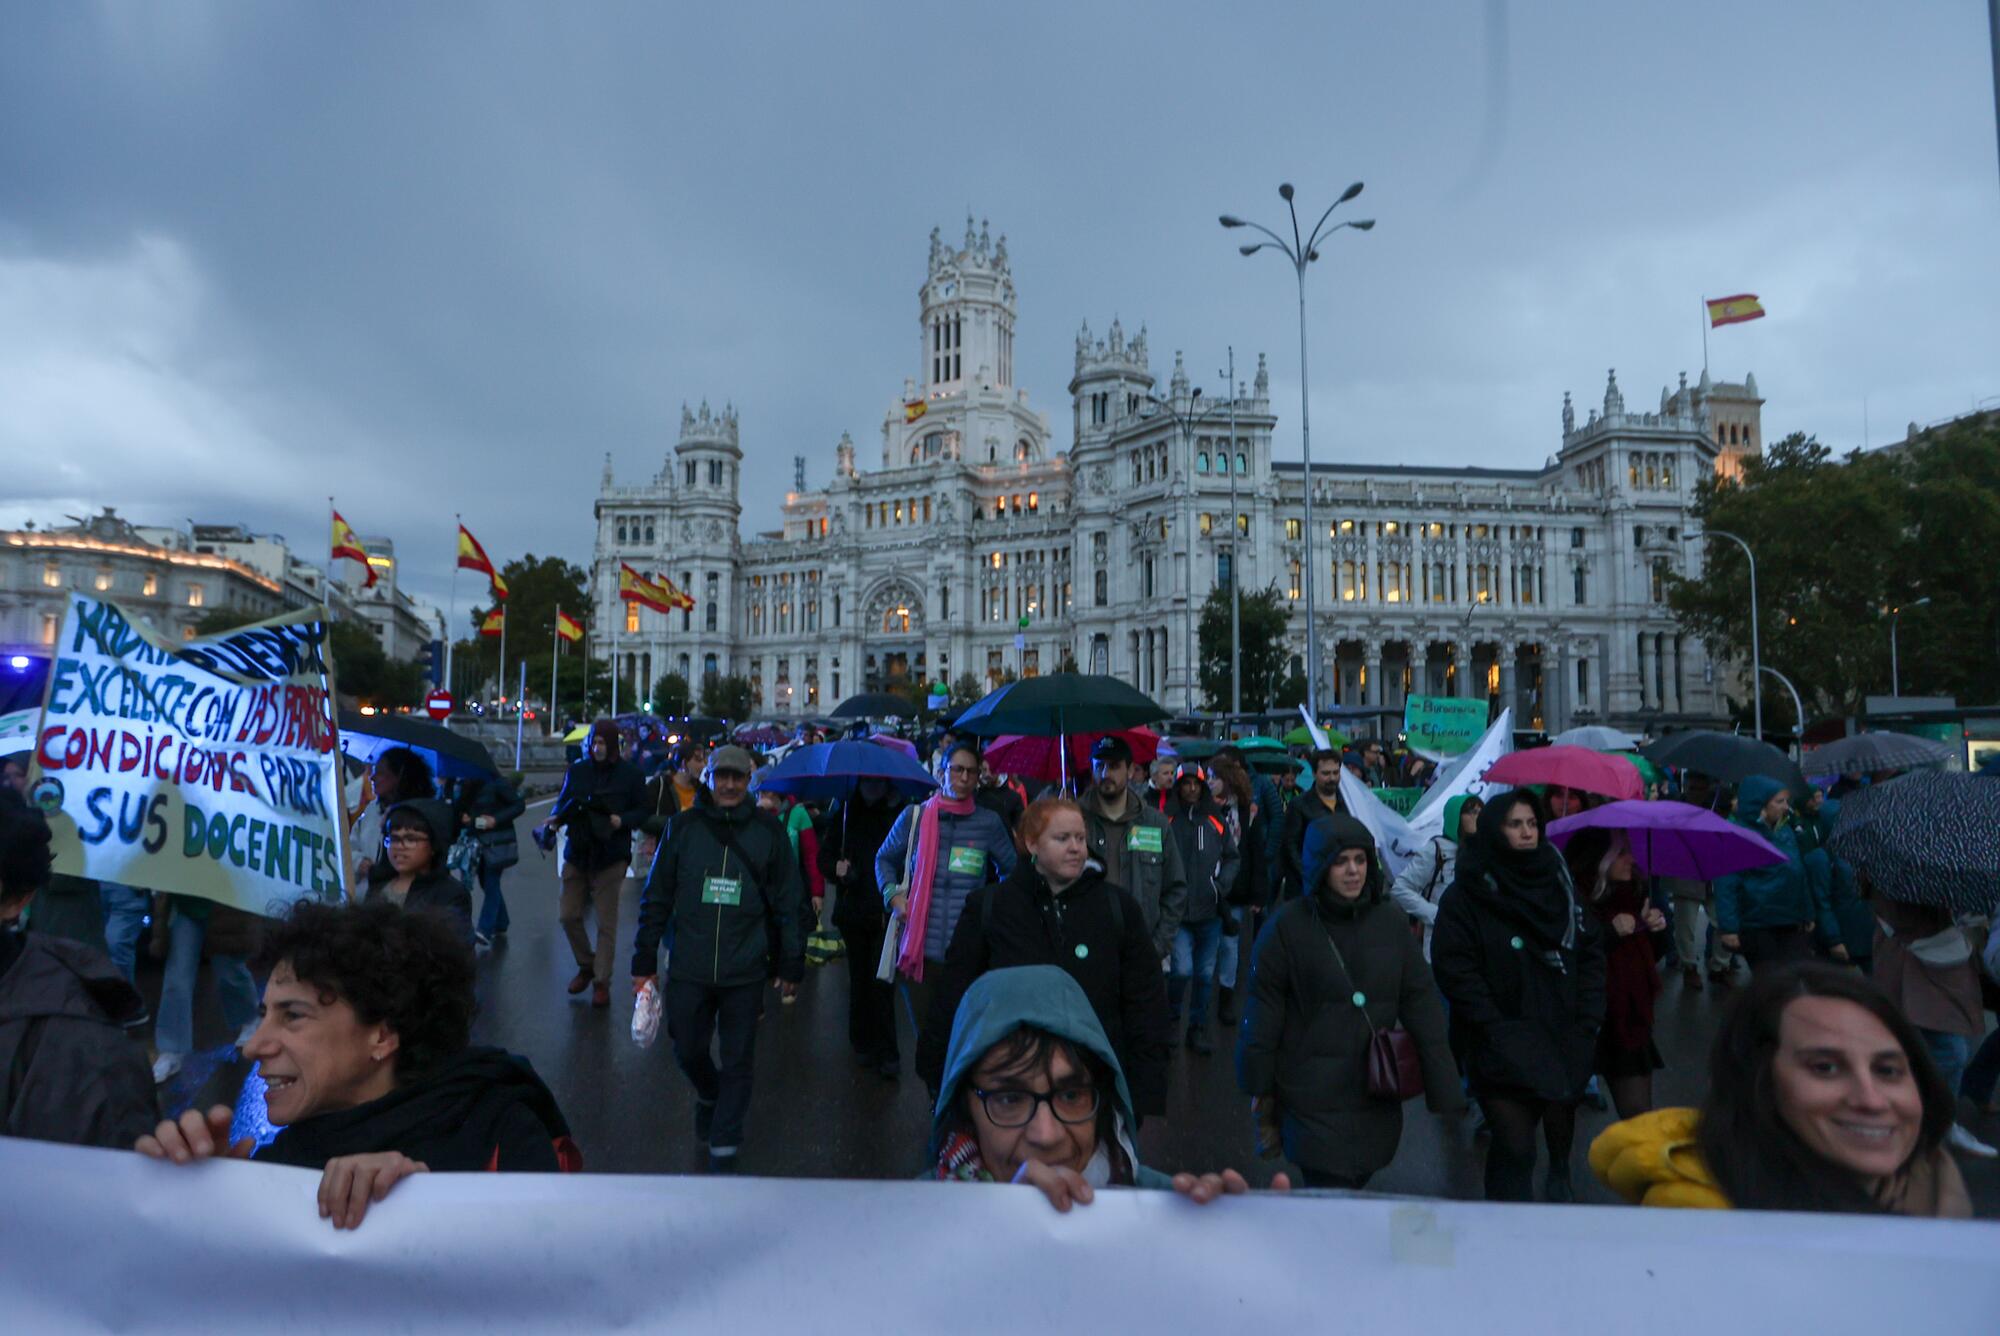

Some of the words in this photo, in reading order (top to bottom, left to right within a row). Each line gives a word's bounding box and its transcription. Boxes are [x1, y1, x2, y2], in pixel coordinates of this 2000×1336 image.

[73, 600, 180, 666] MAD
[186, 687, 243, 742] CON
[235, 684, 280, 745] LAS
[1422, 723, 1471, 744] Eficacia
[260, 752, 328, 820] PARA
[78, 787, 168, 854] SUS
[183, 804, 342, 901] DOCENTES
